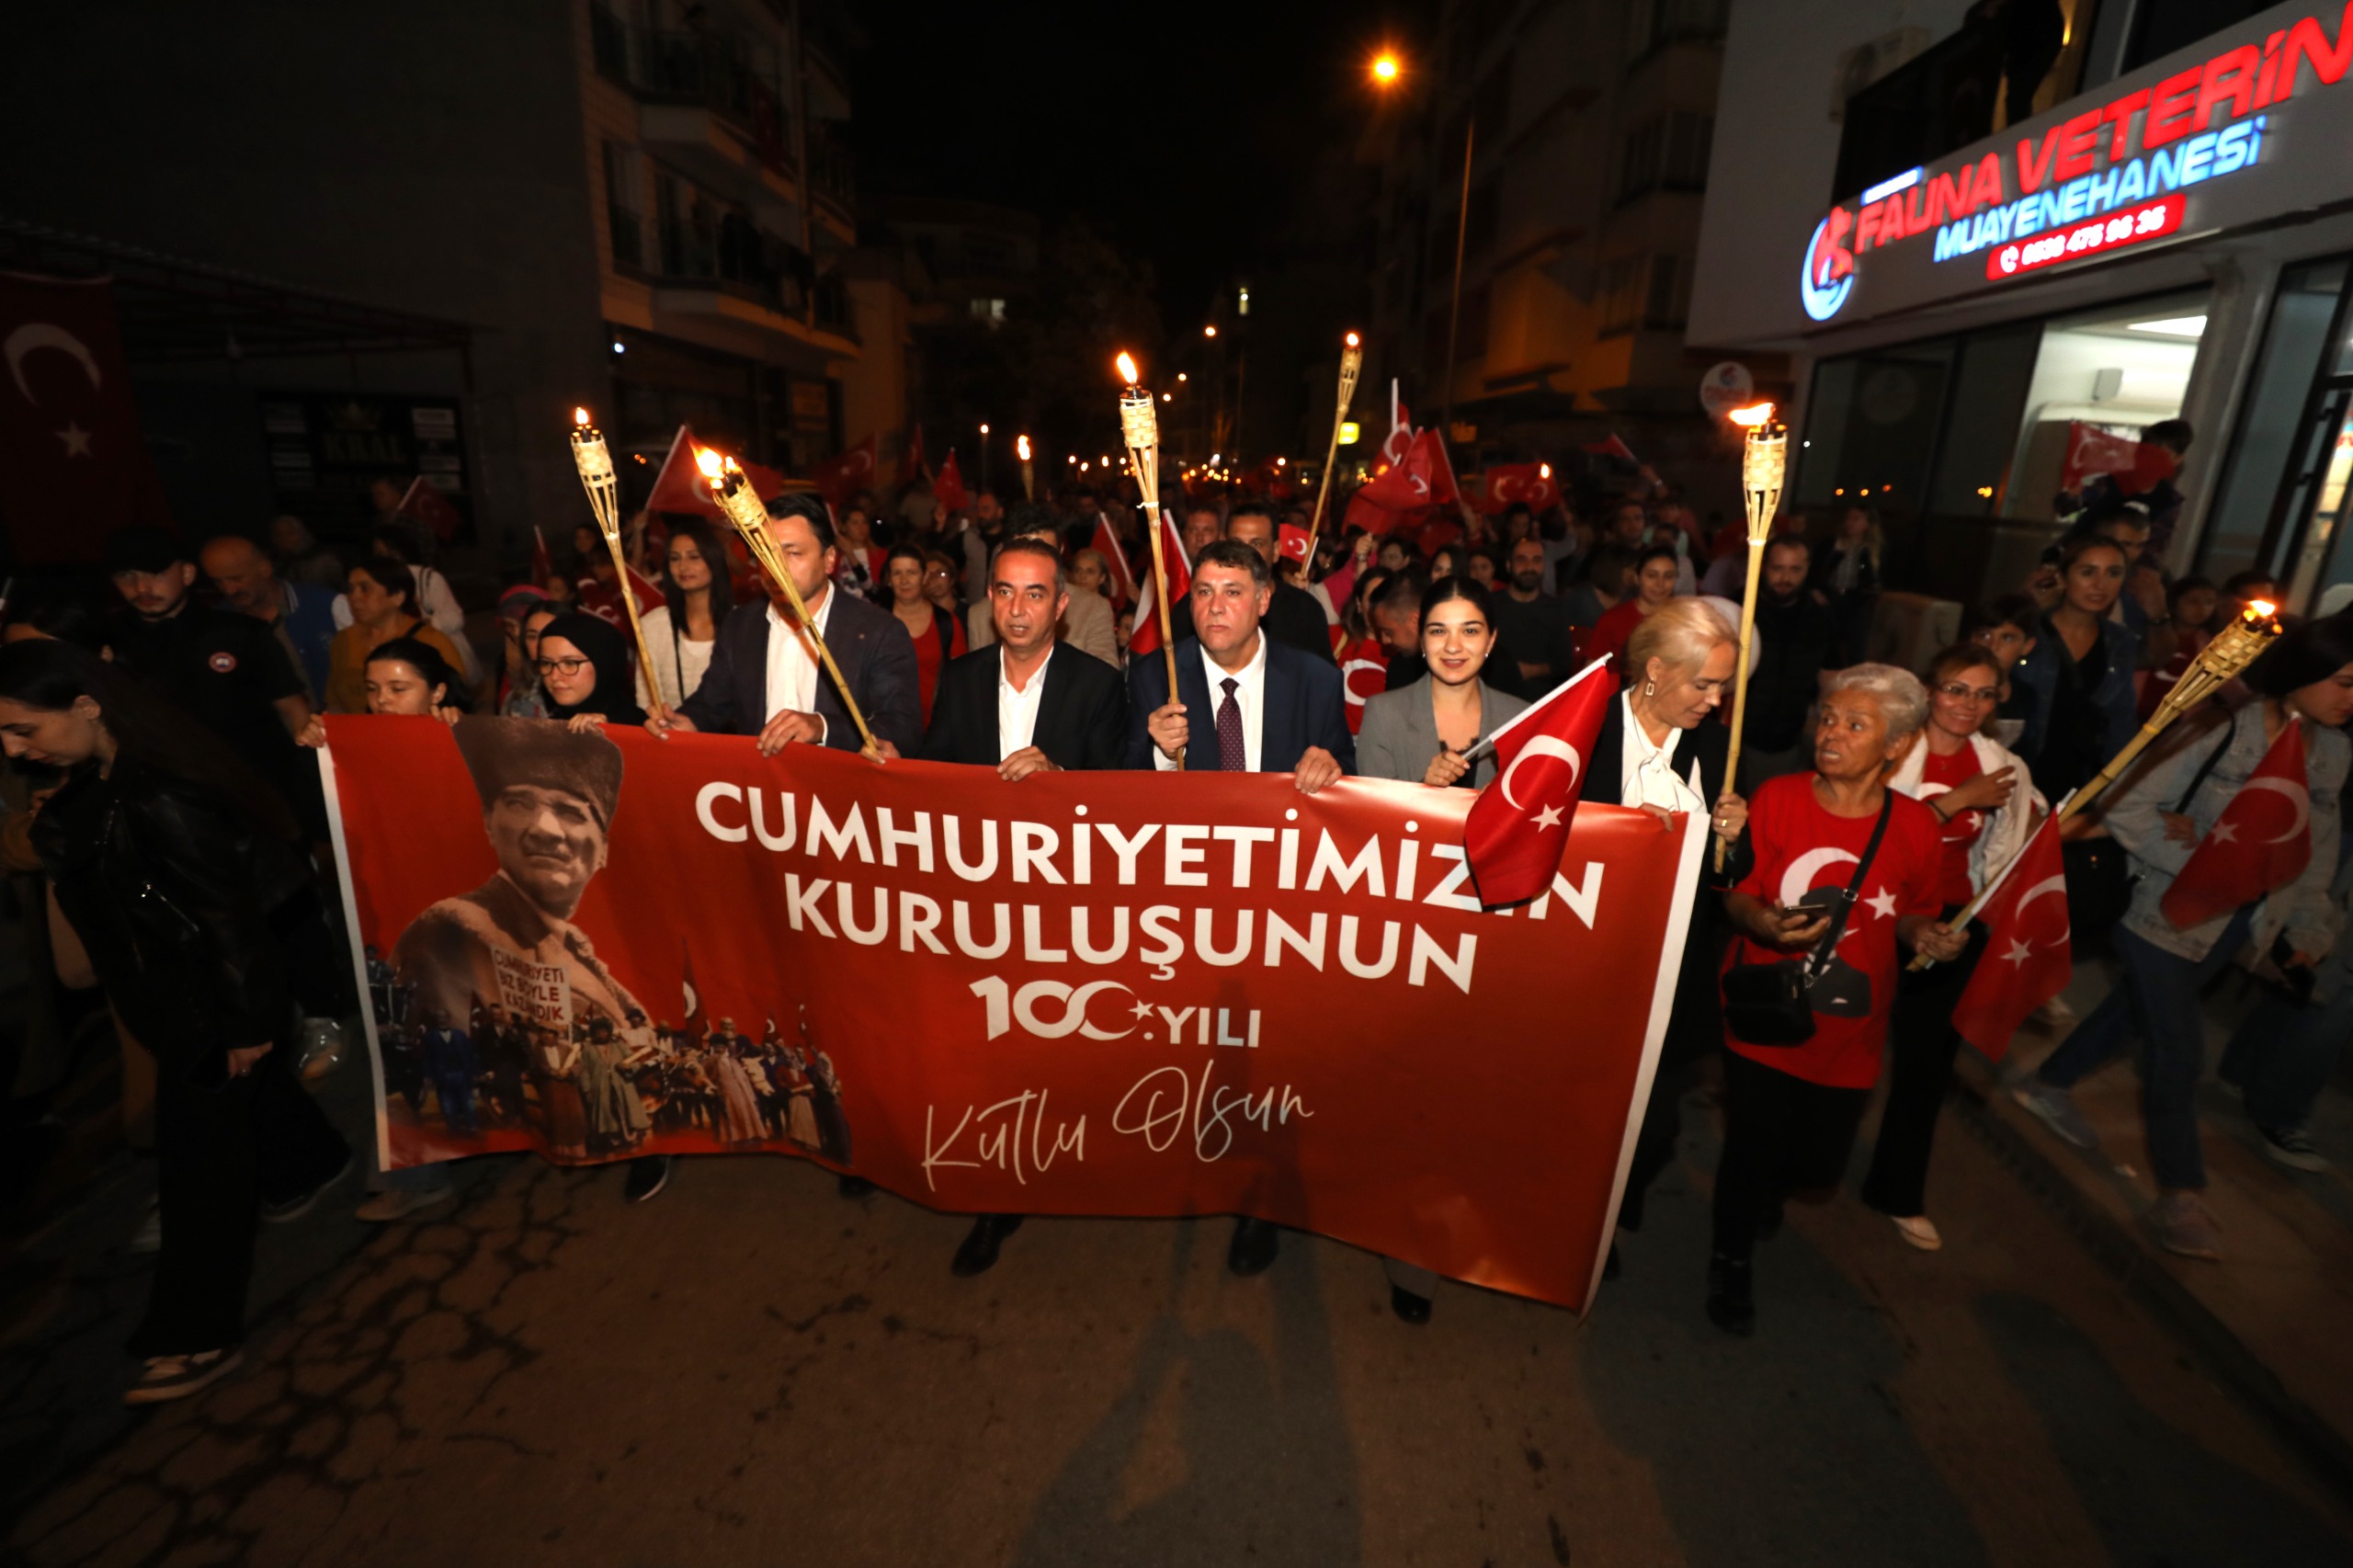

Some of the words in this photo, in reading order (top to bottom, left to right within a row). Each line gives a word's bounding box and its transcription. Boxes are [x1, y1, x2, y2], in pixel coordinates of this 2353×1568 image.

[1855, 153, 2004, 255] FAUNA
[1933, 115, 2268, 263] MUAYENEHANESİ
[695, 780, 1605, 930] CUMHURİYETİMİZN
[784, 872, 1478, 995] KURULUŞUNUN
[921, 1088, 1086, 1192] Kutlu
[1112, 1059, 1314, 1163] Olsun
